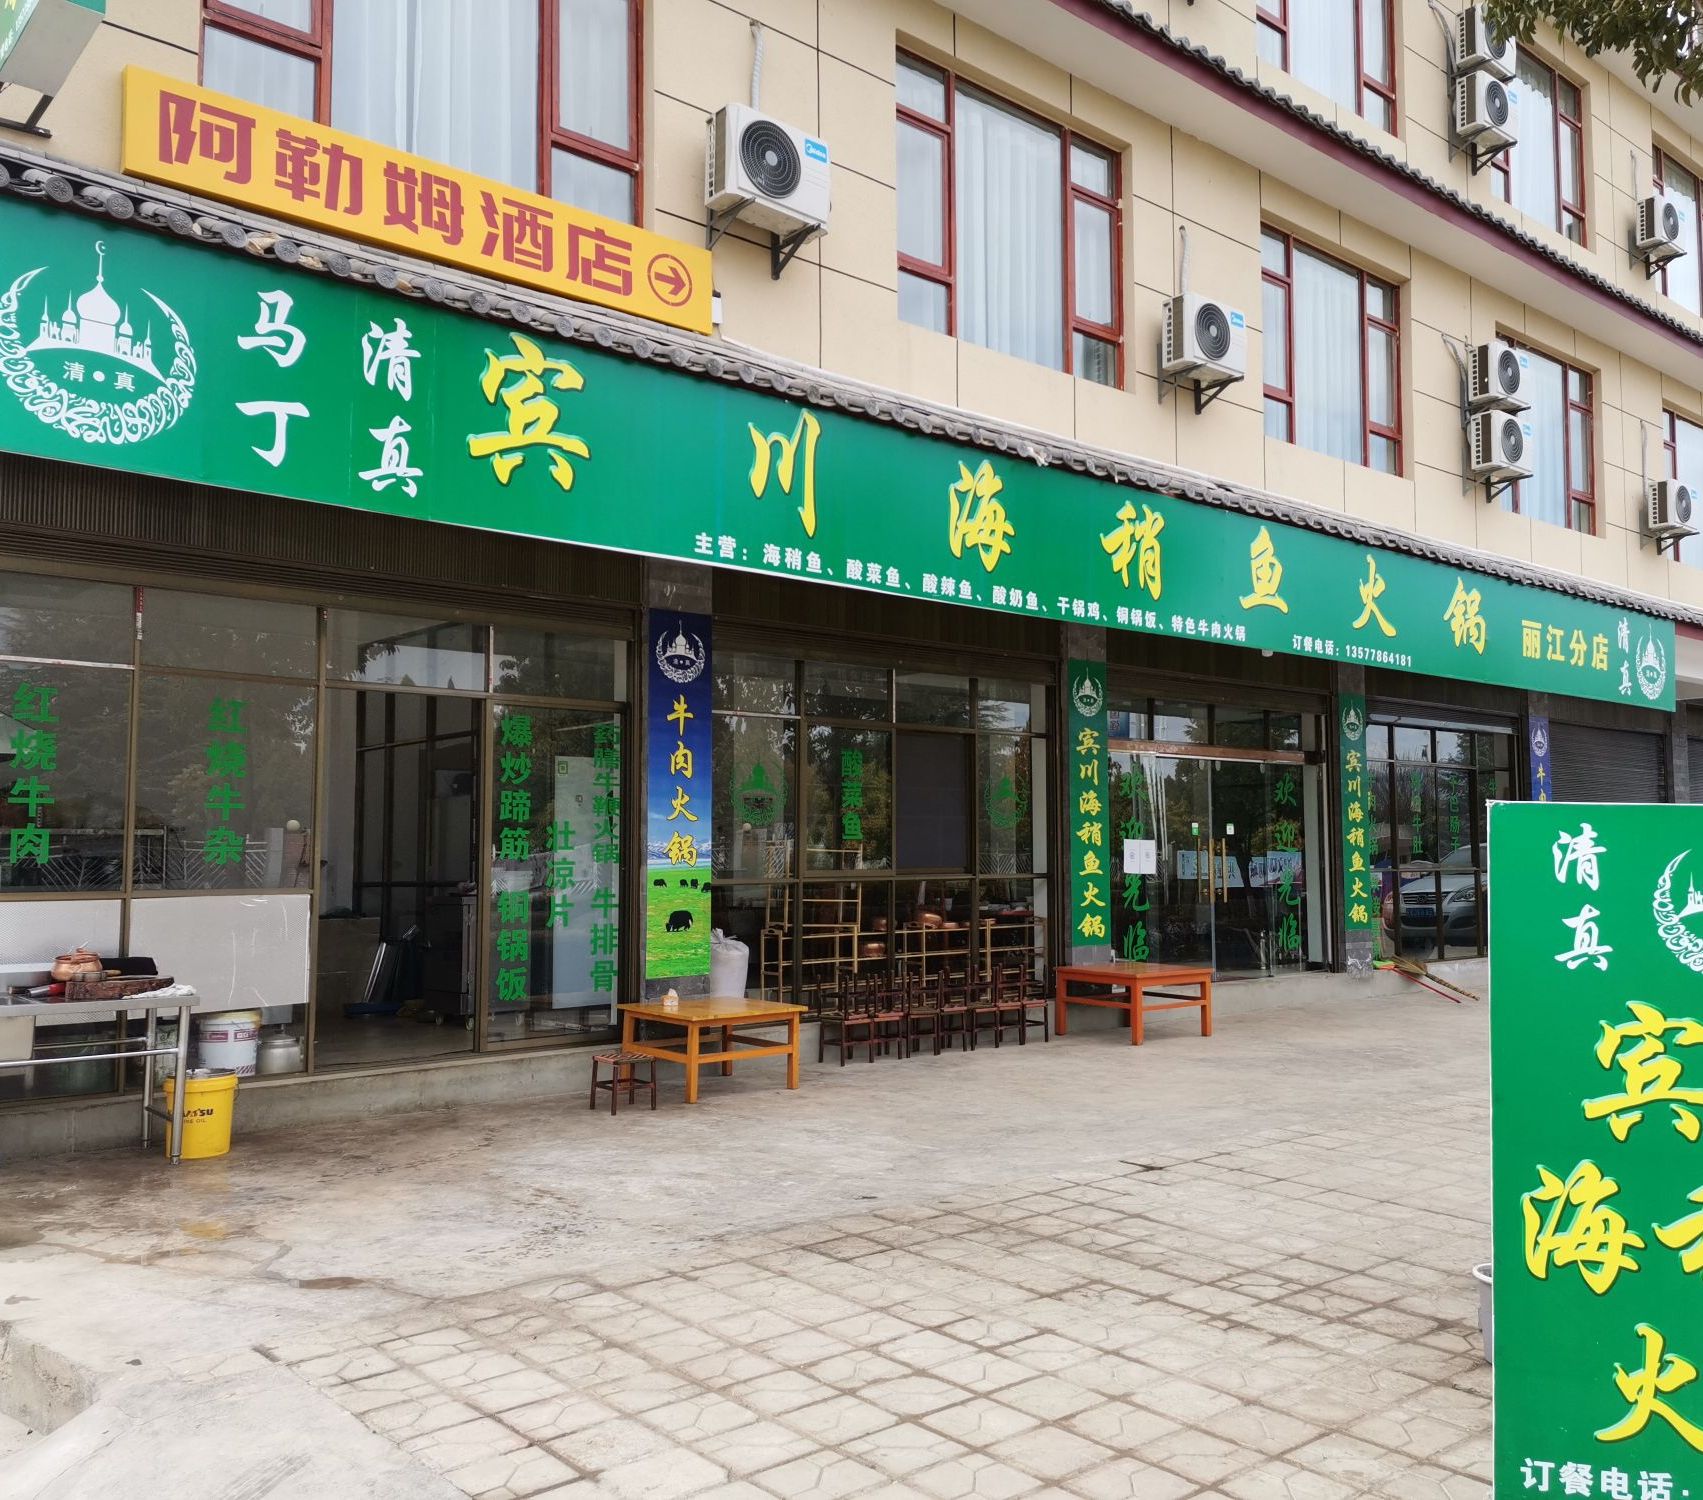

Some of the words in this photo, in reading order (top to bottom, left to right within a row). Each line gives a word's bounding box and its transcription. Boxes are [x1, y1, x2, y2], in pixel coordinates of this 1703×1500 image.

[159, 90, 633, 297] 阿勒姆酒店
[235, 291, 309, 468] 马丁
[358, 318, 424, 498] 清真
[1521, 619, 1609, 671] 丽江分店
[1617, 616, 1632, 696] 清真
[9, 682, 60, 866] 红烧牛肉
[204, 698, 247, 865] 红烧牛杂
[499, 715, 533, 862] 爆炒蹄筋
[663, 693, 698, 868] 牛肉火锅
[841, 749, 864, 840] 酸菜鱼
[1076, 727, 1106, 938] 宾川海稍鱼火锅
[1345, 750, 1368, 923] 宾川海稍鱼火锅
[590, 887, 618, 992] 牛排骨
[1273, 772, 1301, 951] 欢迎光临
[1552, 822, 1614, 971] 清真
[496, 890, 529, 1001] 铜锅饭
[1594, 1322, 1703, 1452] 火
